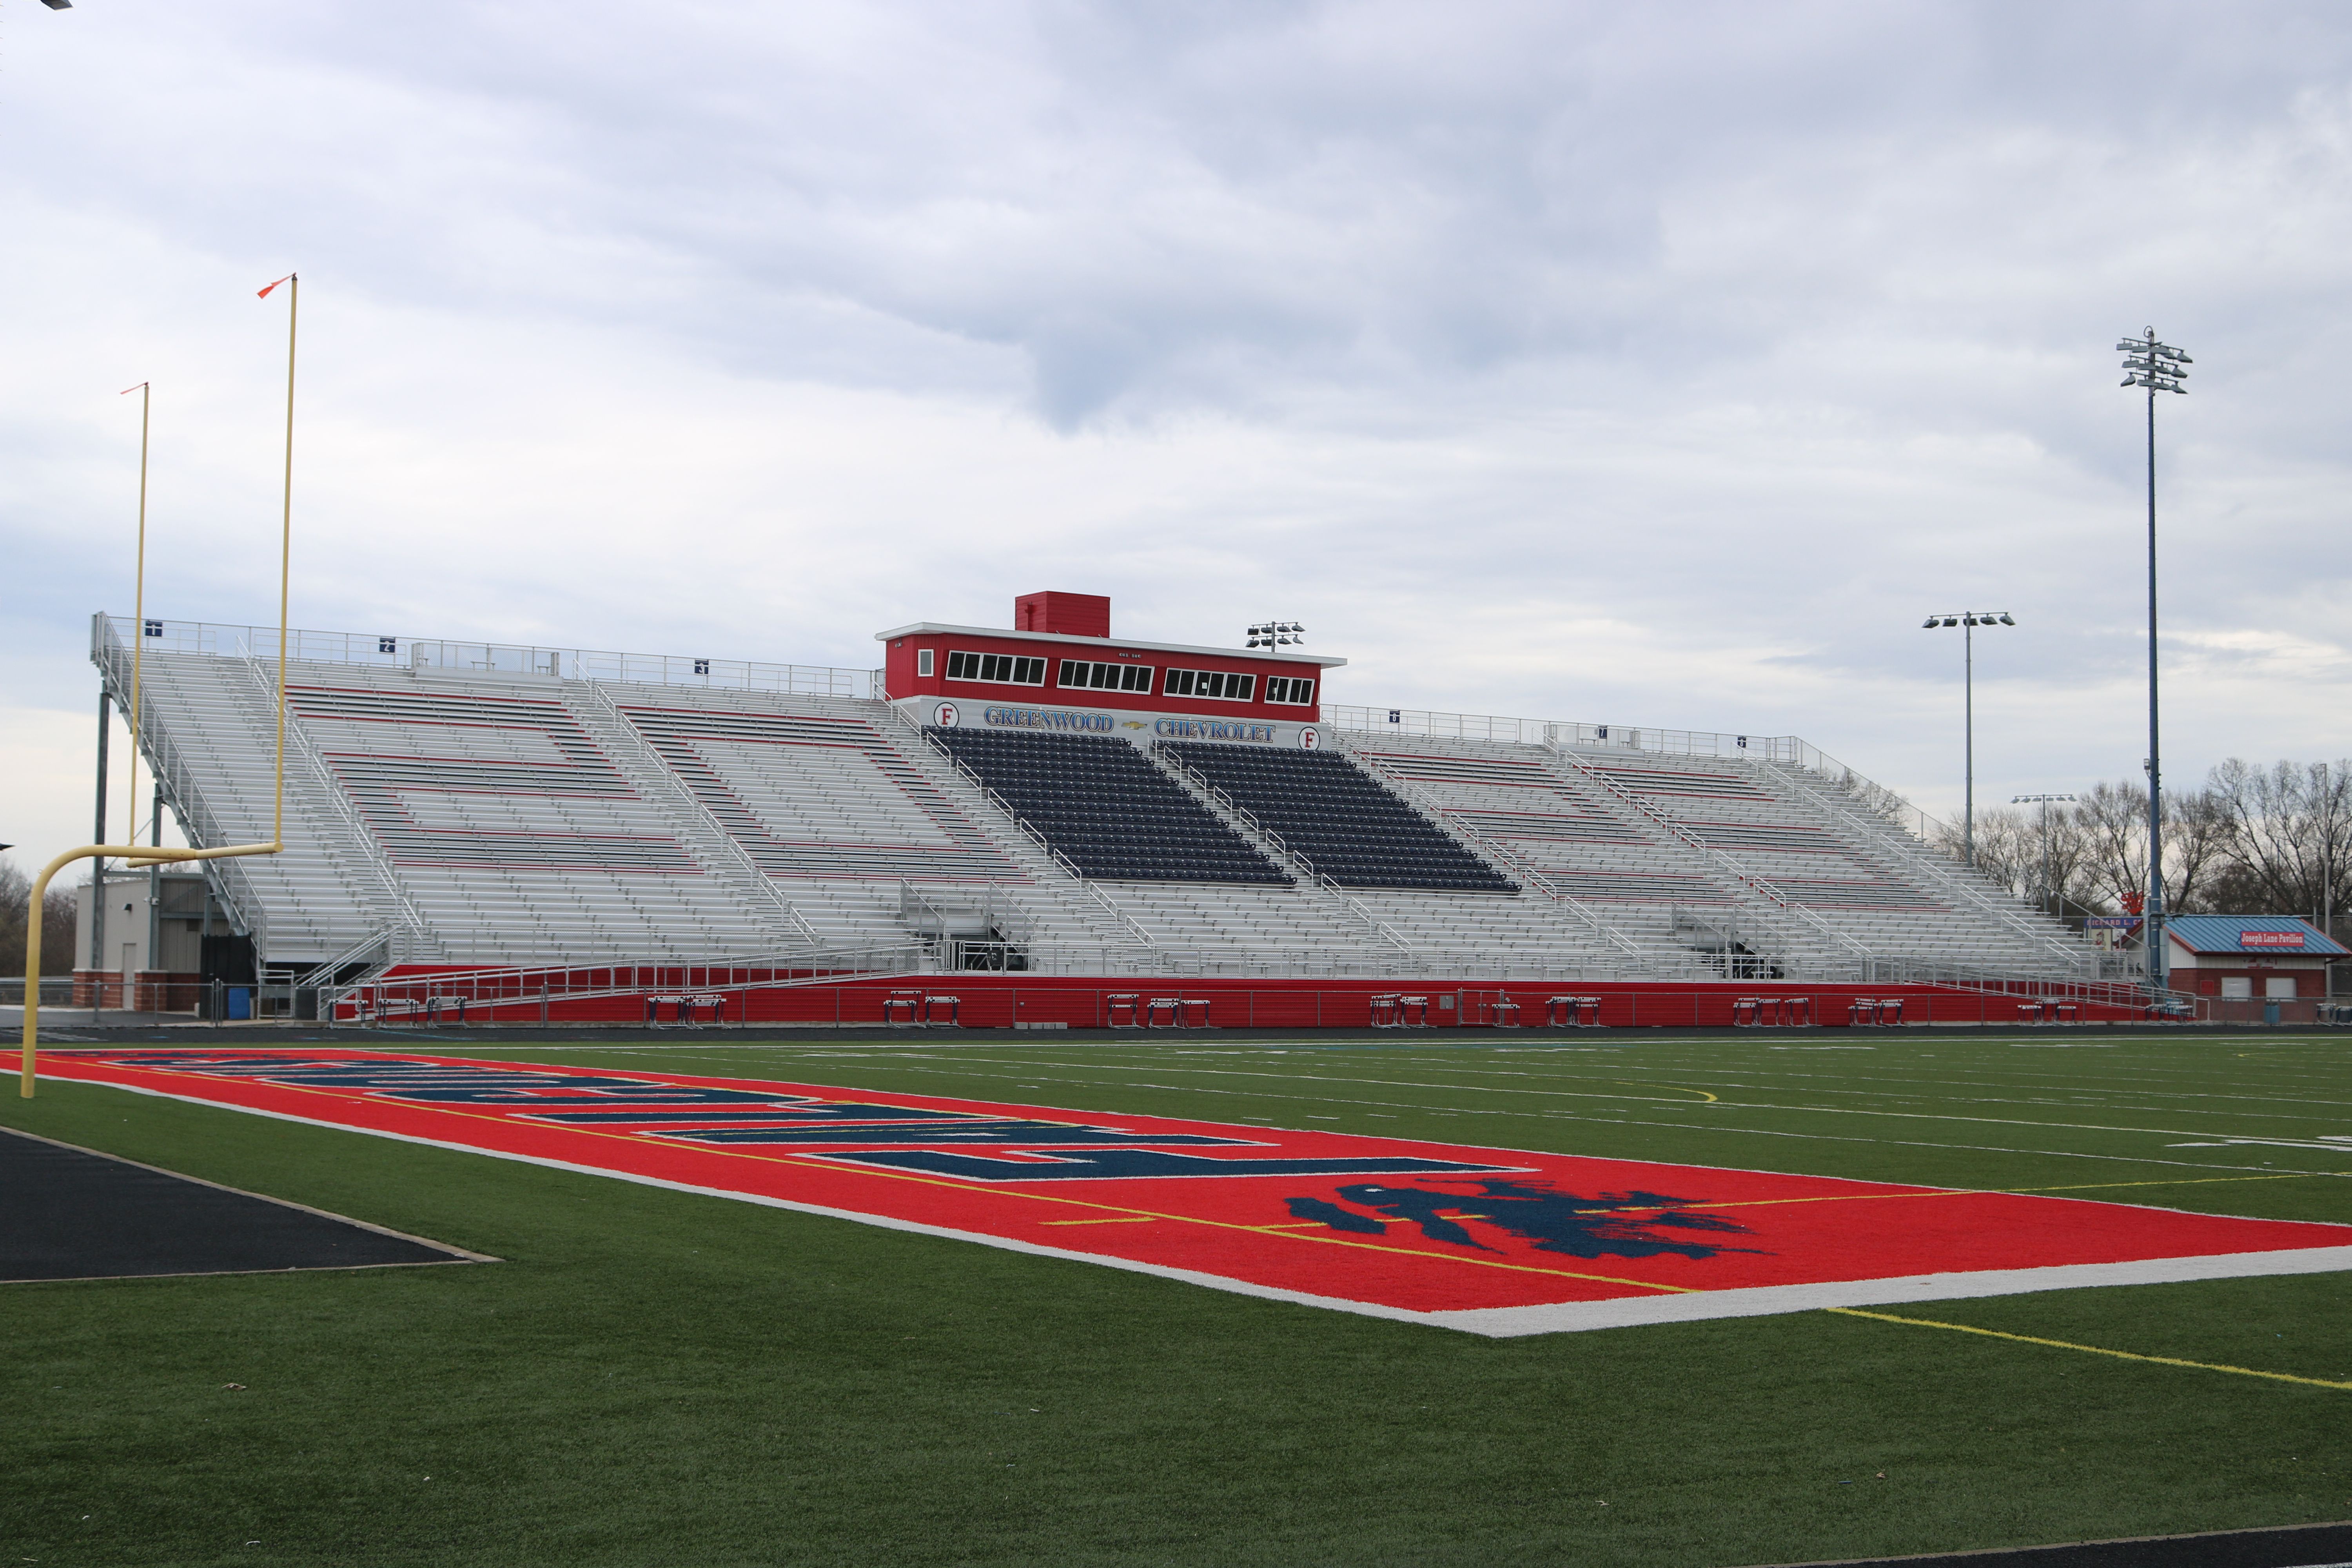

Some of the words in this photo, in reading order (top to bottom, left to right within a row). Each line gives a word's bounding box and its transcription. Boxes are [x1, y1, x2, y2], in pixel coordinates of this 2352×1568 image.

[384, 641, 390, 652] 2
[941, 707, 953, 726] F
[984, 706, 1114, 733] GREENWOOD
[1154, 718, 1276, 743] CHEVROLET
[1304, 731, 1315, 748] F
[1600, 729, 1604, 737] 7
[2241, 933, 2262, 945] Joseph
[2263, 934, 2278, 942] Lane
[2279, 934, 2303, 943] Pavilion
